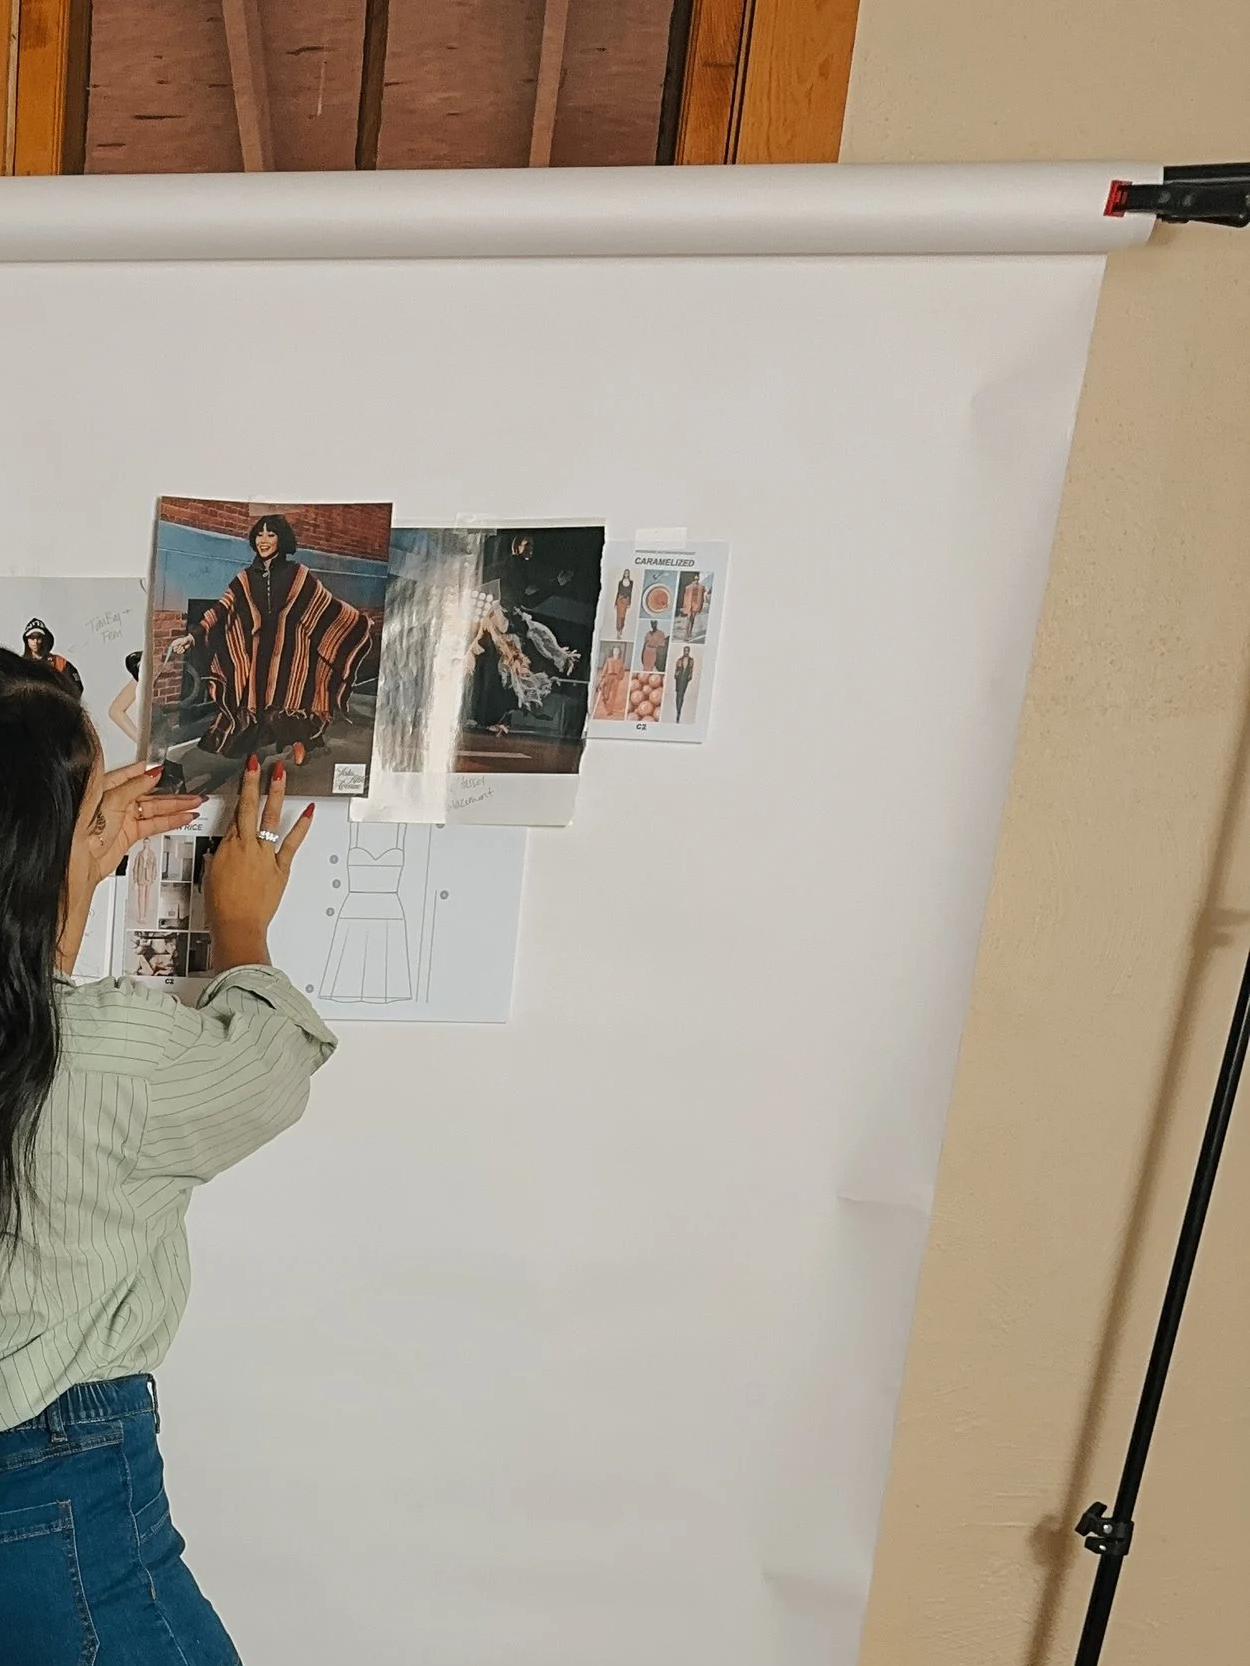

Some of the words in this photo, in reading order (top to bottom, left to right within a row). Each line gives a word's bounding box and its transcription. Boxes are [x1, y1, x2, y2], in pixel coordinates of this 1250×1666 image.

[634, 556, 696, 568] CARAMELIZED
[635, 723, 647, 731] C2
[184, 823, 203, 832] RICE
